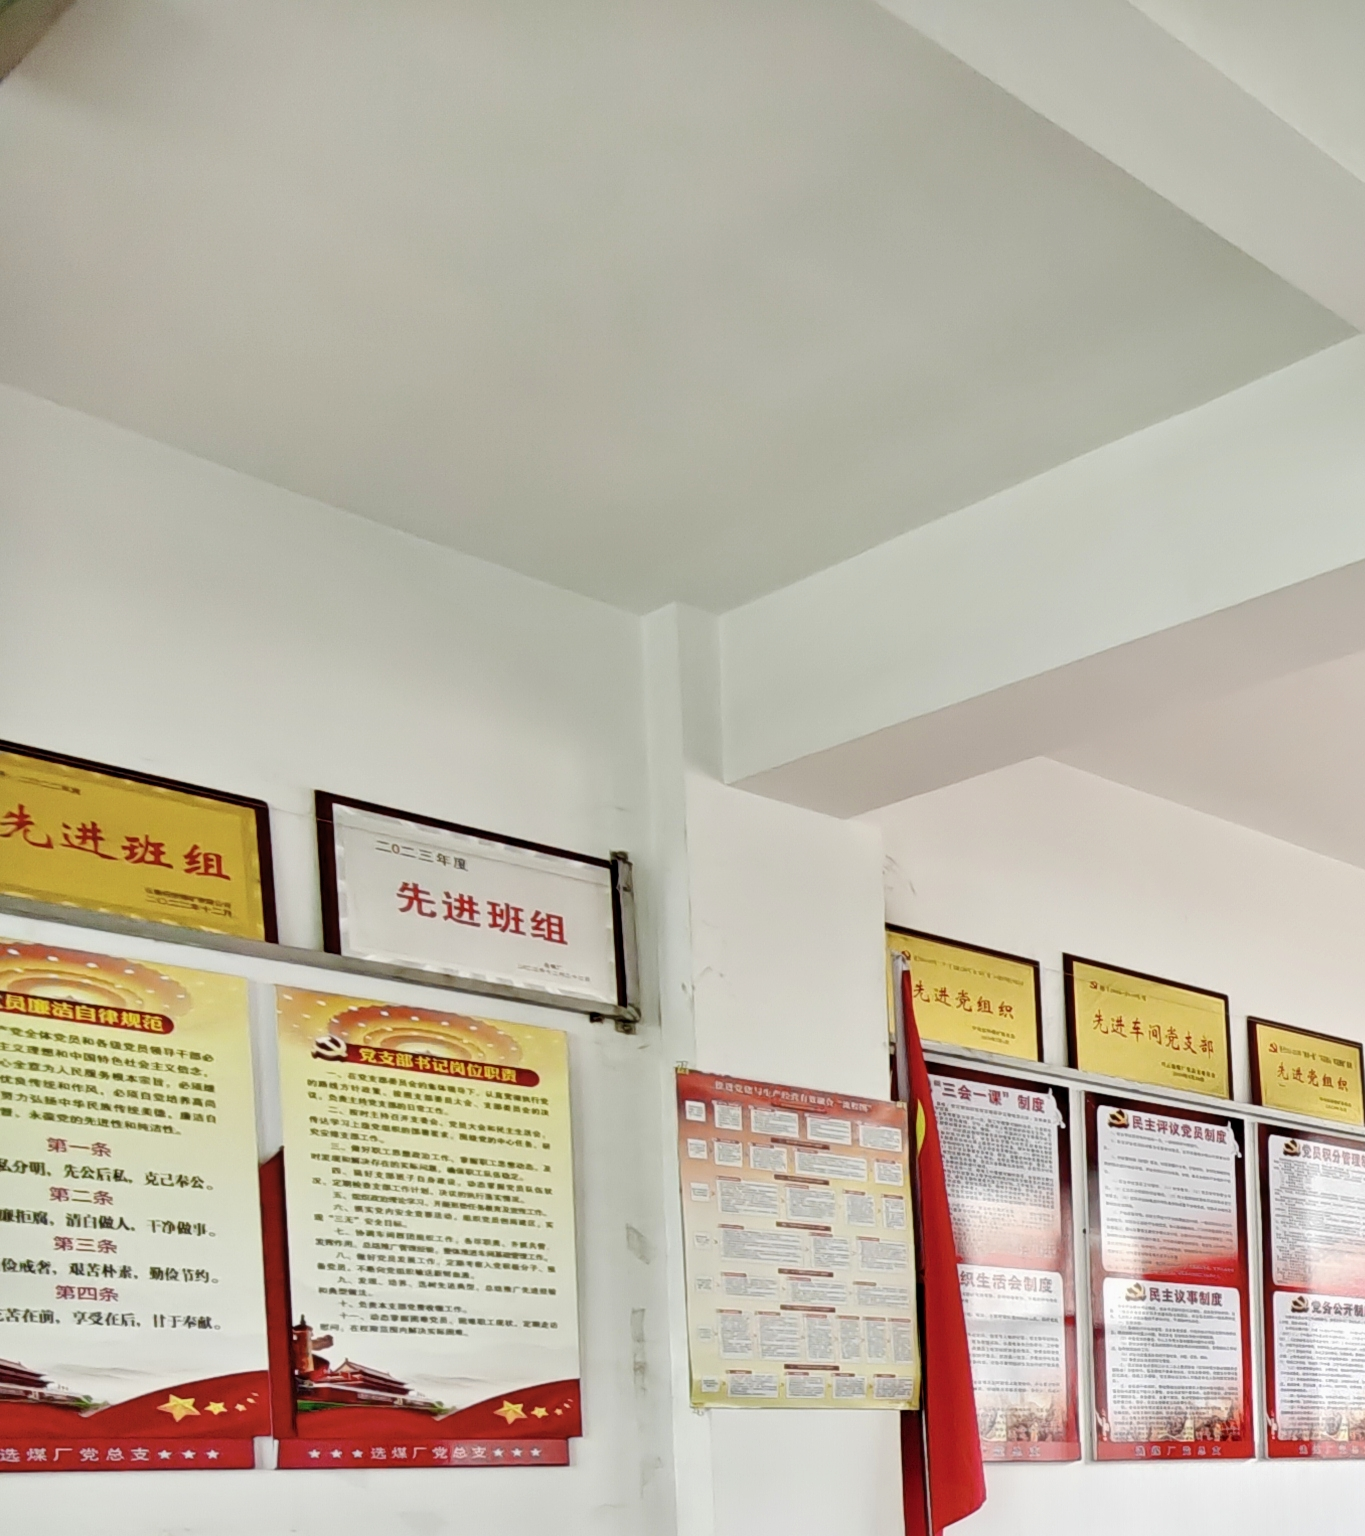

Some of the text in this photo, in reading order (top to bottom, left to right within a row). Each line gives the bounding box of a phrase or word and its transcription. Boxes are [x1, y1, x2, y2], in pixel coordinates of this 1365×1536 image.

[0, 803, 231, 881] 先进班组
[396, 881, 569, 945] 先进班组
[0, 993, 165, 1032] 员廉洁自律规范
[913, 980, 1015, 1020] 先进党组织
[1092, 1009, 1214, 1059] 先进车间党支部
[358, 1047, 517, 1083] 党支部书记岗位职责
[1277, 1062, 1349, 1093] 先进党组织
[1131, 1115, 1228, 1145] 民主评议党员制度
[46, 1137, 112, 1158] 第一条
[49, 1187, 114, 1206] 第二条
[53, 1236, 118, 1254] 第三条
[55, 1285, 119, 1302] 第四条
[1148, 1287, 1223, 1307] 民主议事制度
[0, 1446, 150, 1464] 选煤厂党总支
[369, 1446, 489, 1462] 选煤厂党总支
